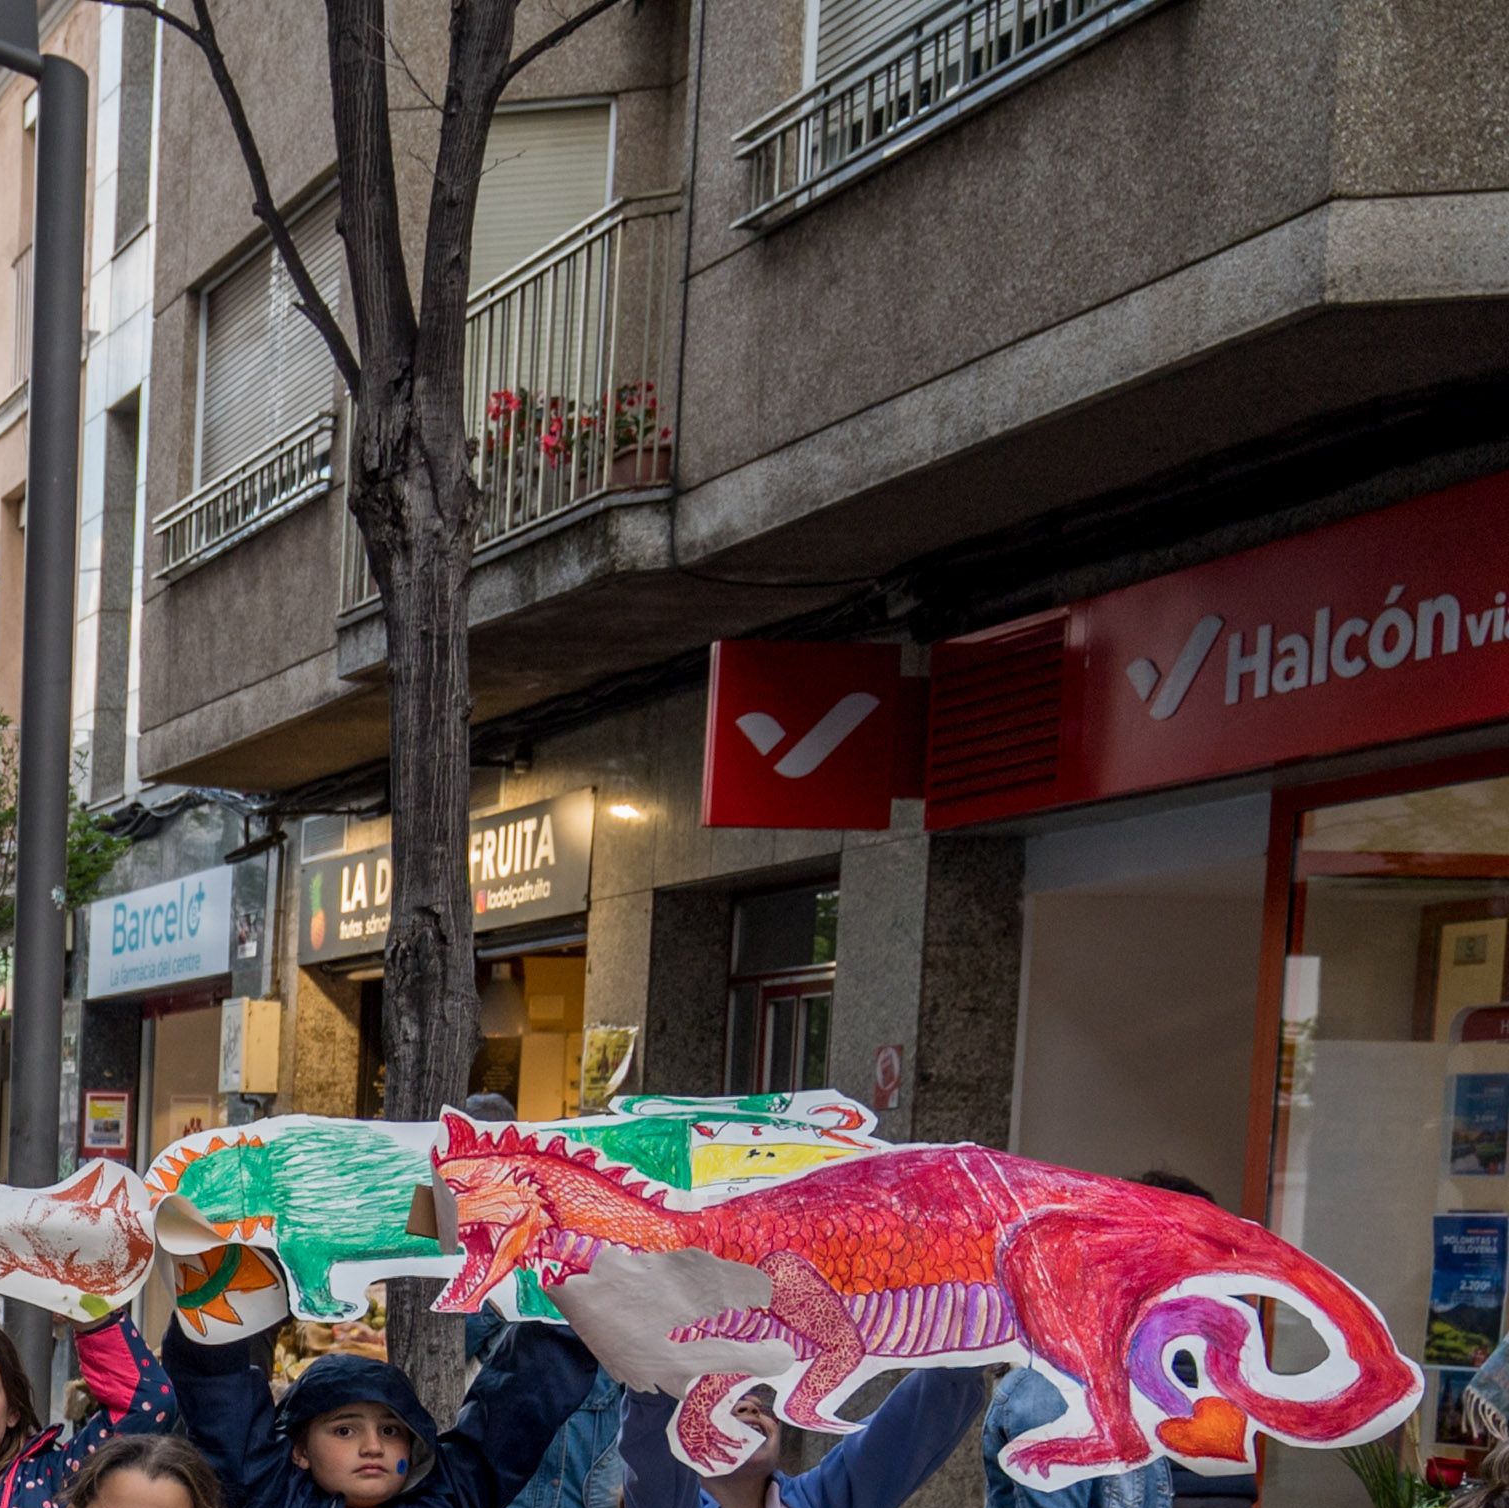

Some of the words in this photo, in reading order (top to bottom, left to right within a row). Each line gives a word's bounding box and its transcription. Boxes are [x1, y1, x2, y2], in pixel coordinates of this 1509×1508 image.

[1225, 584, 1461, 706] Halcón
[1465, 591, 1509, 648] vi
[340, 861, 367, 914] LA
[469, 813, 556, 884] FRUITA
[339, 915, 363, 940] frutas
[365, 912, 392, 935] sánch
[110, 968, 119, 987] La
[157, 954, 171, 977] del
[173, 952, 201, 973] centre
